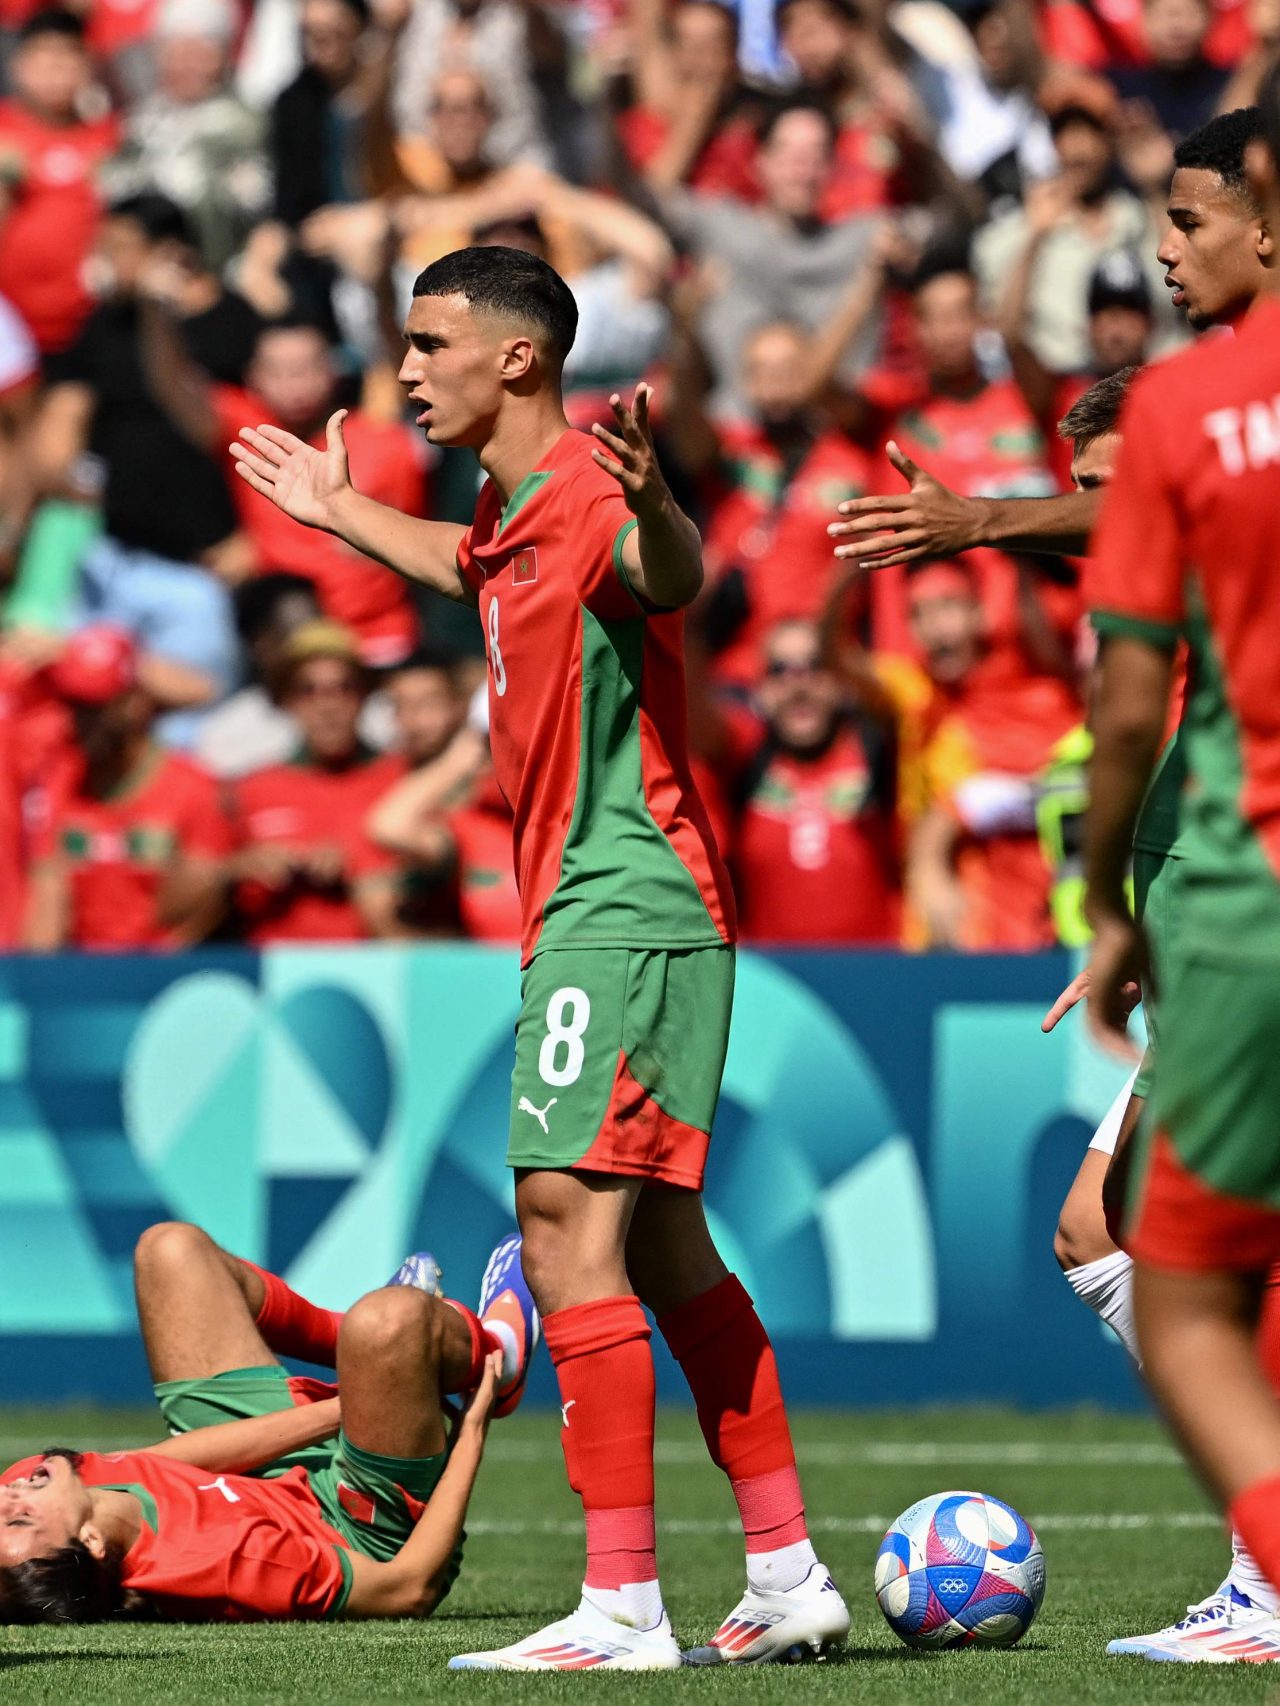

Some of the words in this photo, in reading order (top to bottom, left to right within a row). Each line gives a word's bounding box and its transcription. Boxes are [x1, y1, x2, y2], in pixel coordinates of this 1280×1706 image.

[1201, 393, 1280, 477] TA
[488, 596, 507, 696] 8
[538, 986, 591, 1087] 8
